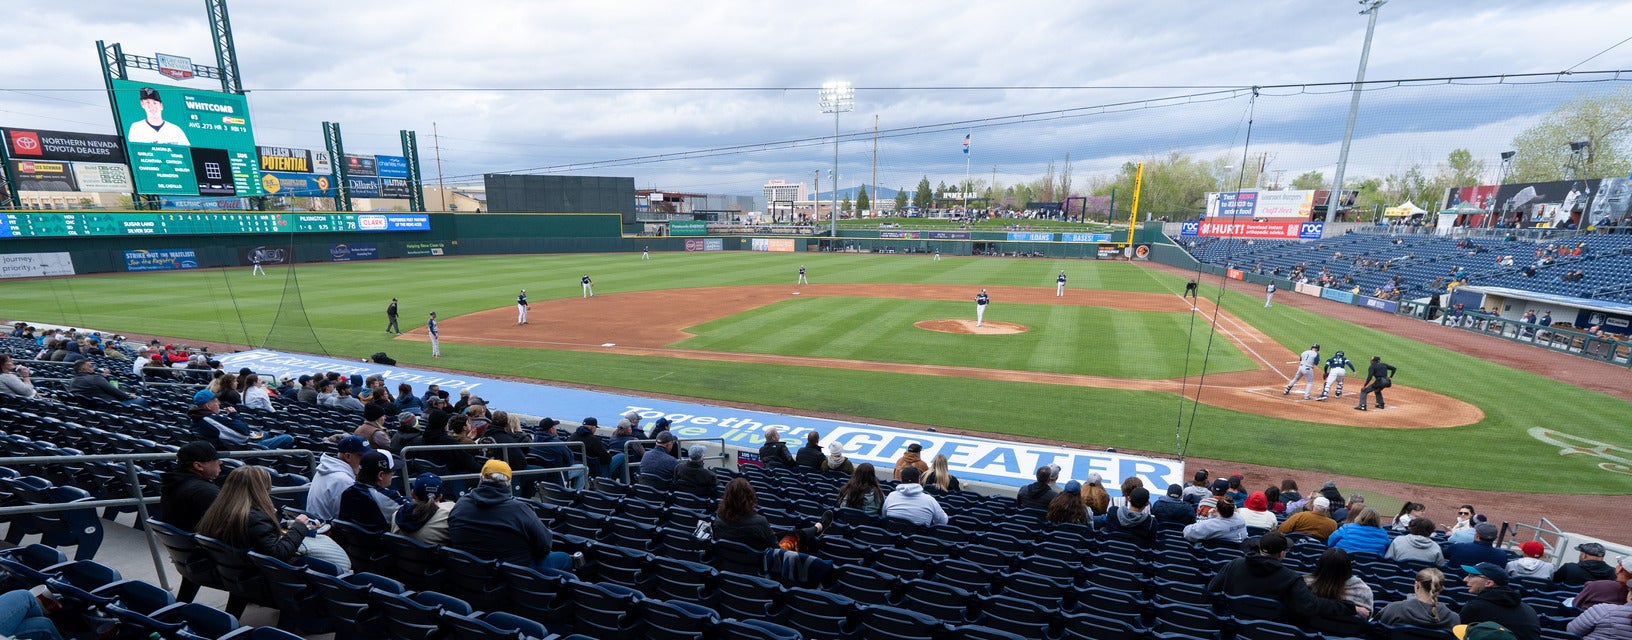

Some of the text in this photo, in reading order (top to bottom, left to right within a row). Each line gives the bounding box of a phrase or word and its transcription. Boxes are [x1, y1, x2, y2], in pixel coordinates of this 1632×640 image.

[186, 101, 233, 113] WHITCOMB
[42, 137, 118, 149] NORTHERN NEVADA
[44, 145, 76, 153] TOYOTA
[261, 147, 306, 158] UNLEASH YOUR
[262, 156, 308, 171] POTENTIAL
[349, 180, 377, 189] Dillard's
[217, 200, 239, 208] Chill
[1212, 224, 1245, 234] HURT!
[1302, 224, 1322, 232] roc
[260, 356, 370, 374] GREATER
[380, 370, 483, 390] NEVADA
[620, 406, 815, 438] Together,
[720, 428, 803, 448] live
[832, 430, 1173, 490] GREATER
